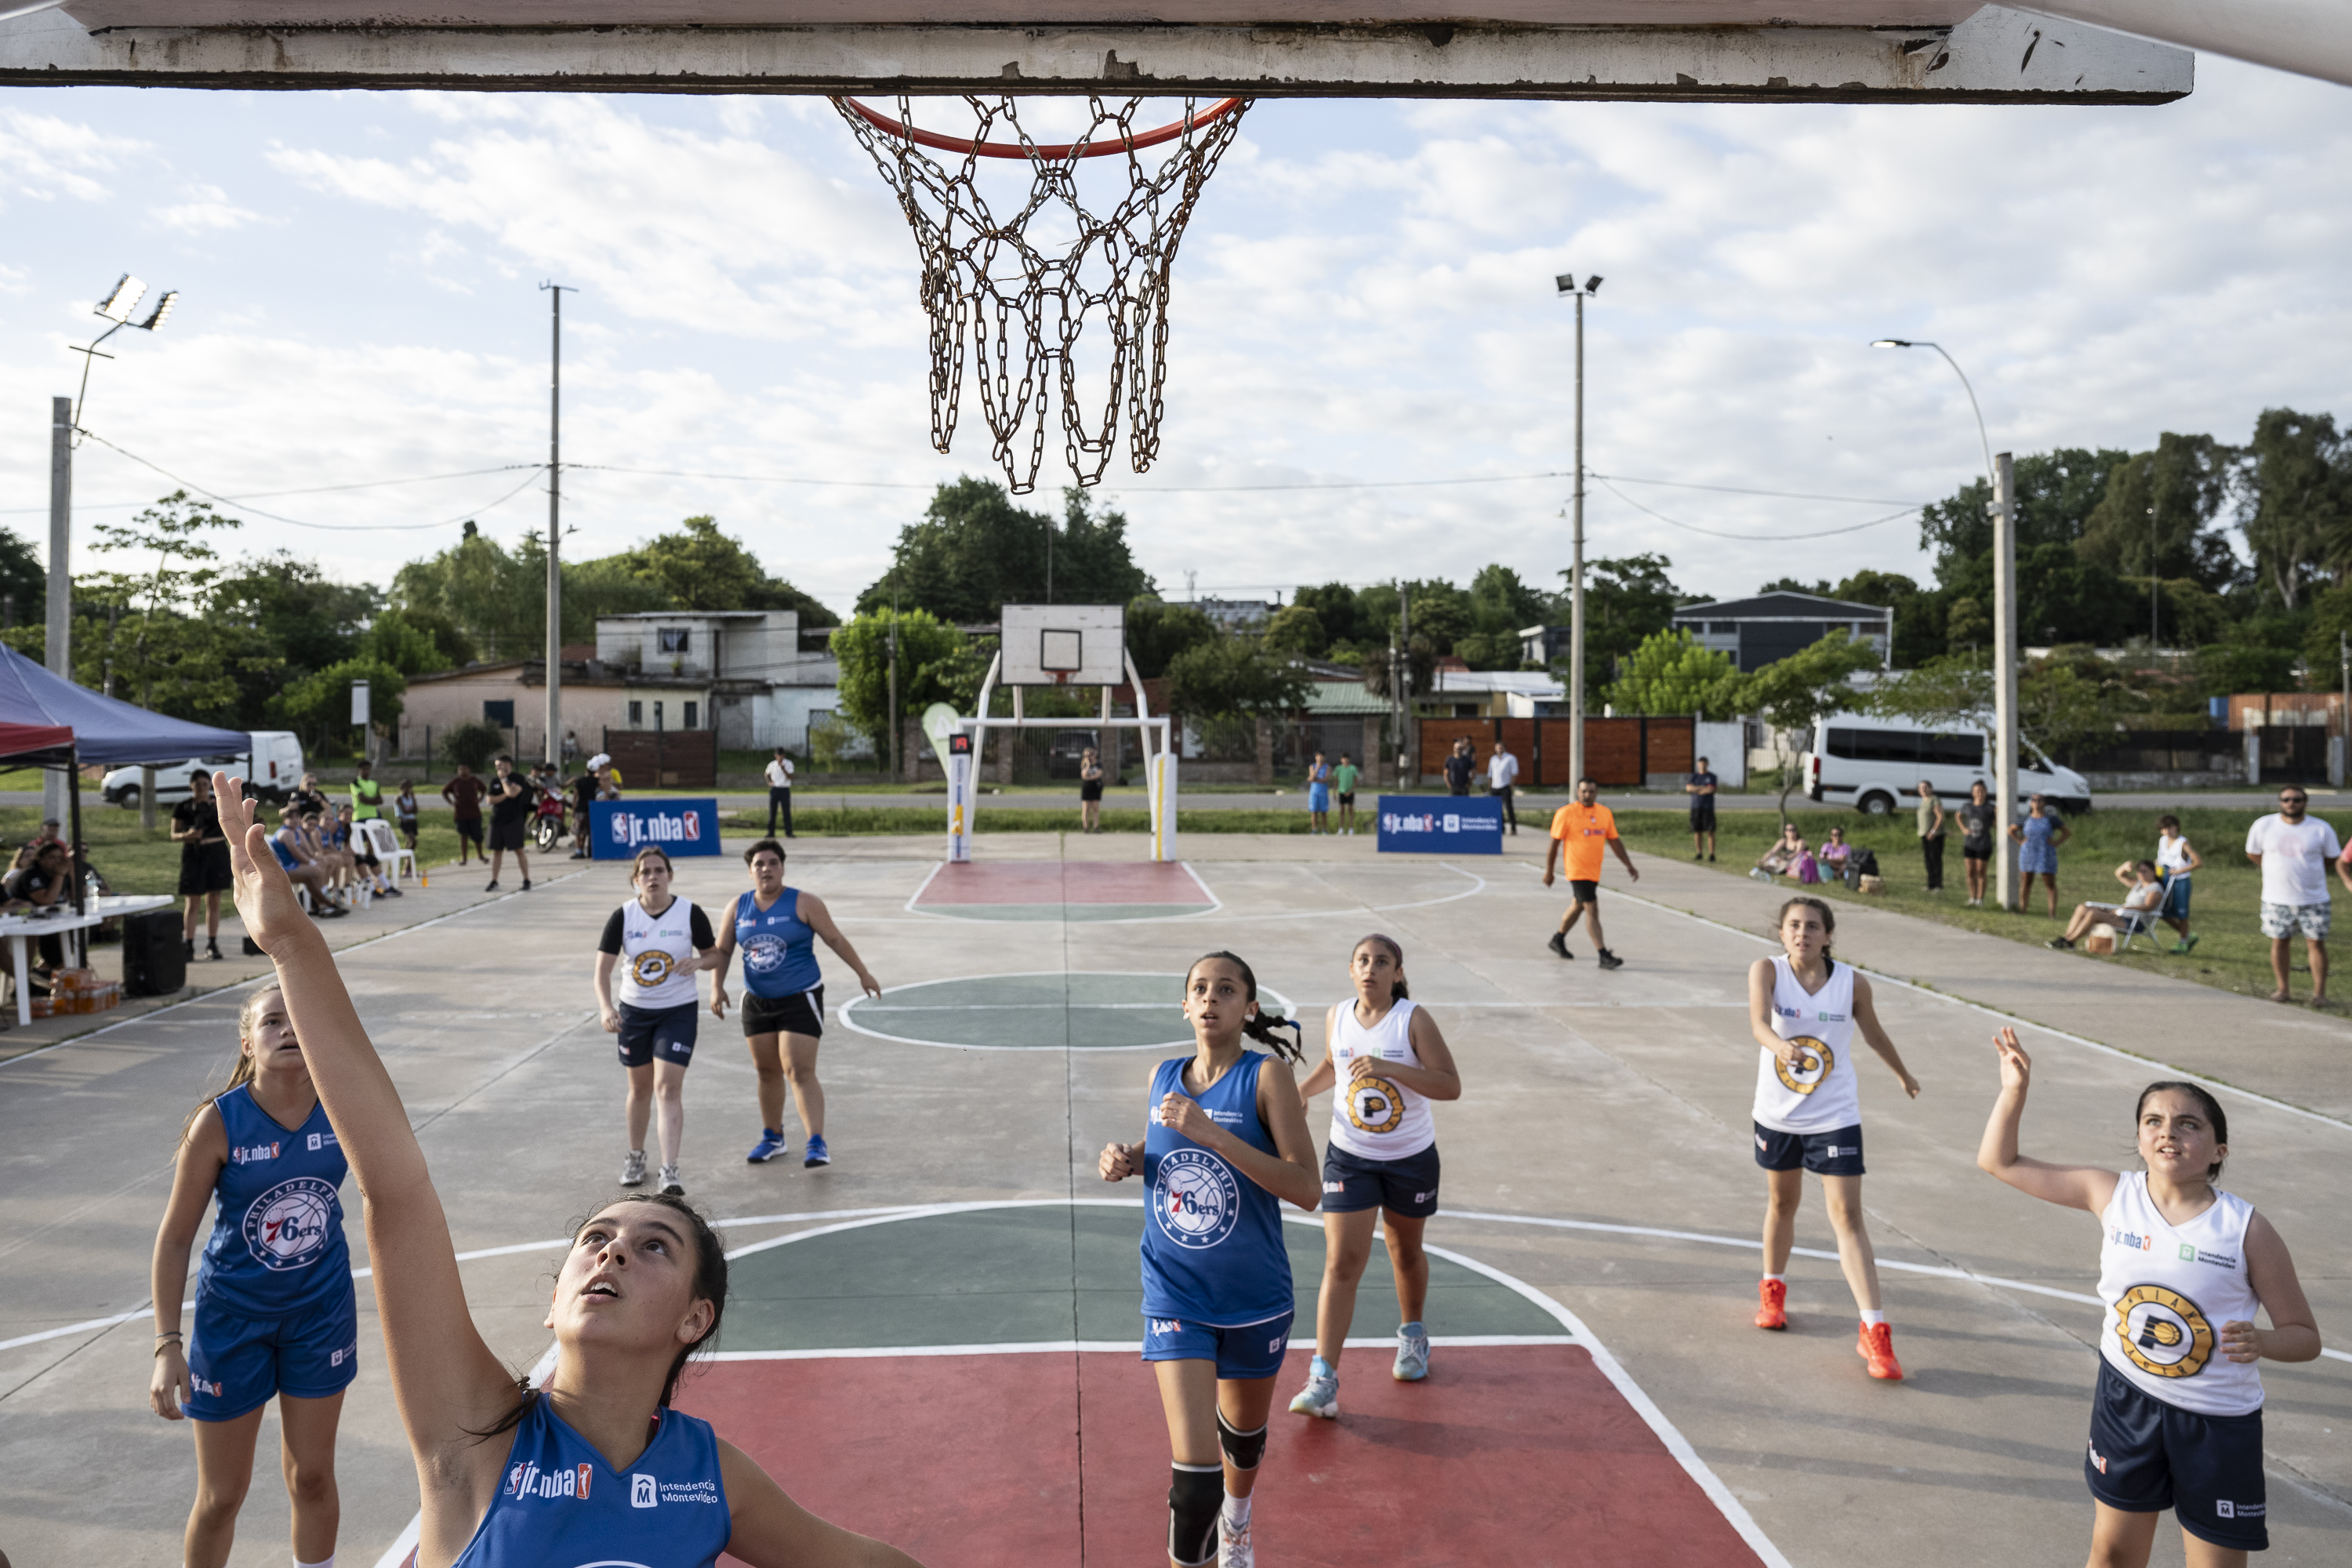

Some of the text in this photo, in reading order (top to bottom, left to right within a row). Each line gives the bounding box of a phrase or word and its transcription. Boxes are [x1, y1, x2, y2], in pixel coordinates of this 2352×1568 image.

[628, 811, 684, 847] jr.nba
[240, 1145, 271, 1165] jr.nba
[1156, 1153, 1236, 1200] PHILADELPHIA
[247, 1181, 335, 1228] PHILADELPH
[1171, 1190, 1219, 1215] 76ers
[266, 1216, 322, 1243] 76ers
[2115, 1228, 2142, 1249] jr.nba
[517, 1460, 575, 1501] jr.nba
[659, 1479, 715, 1492] Intendencia
[662, 1490, 718, 1504] Montevideo
